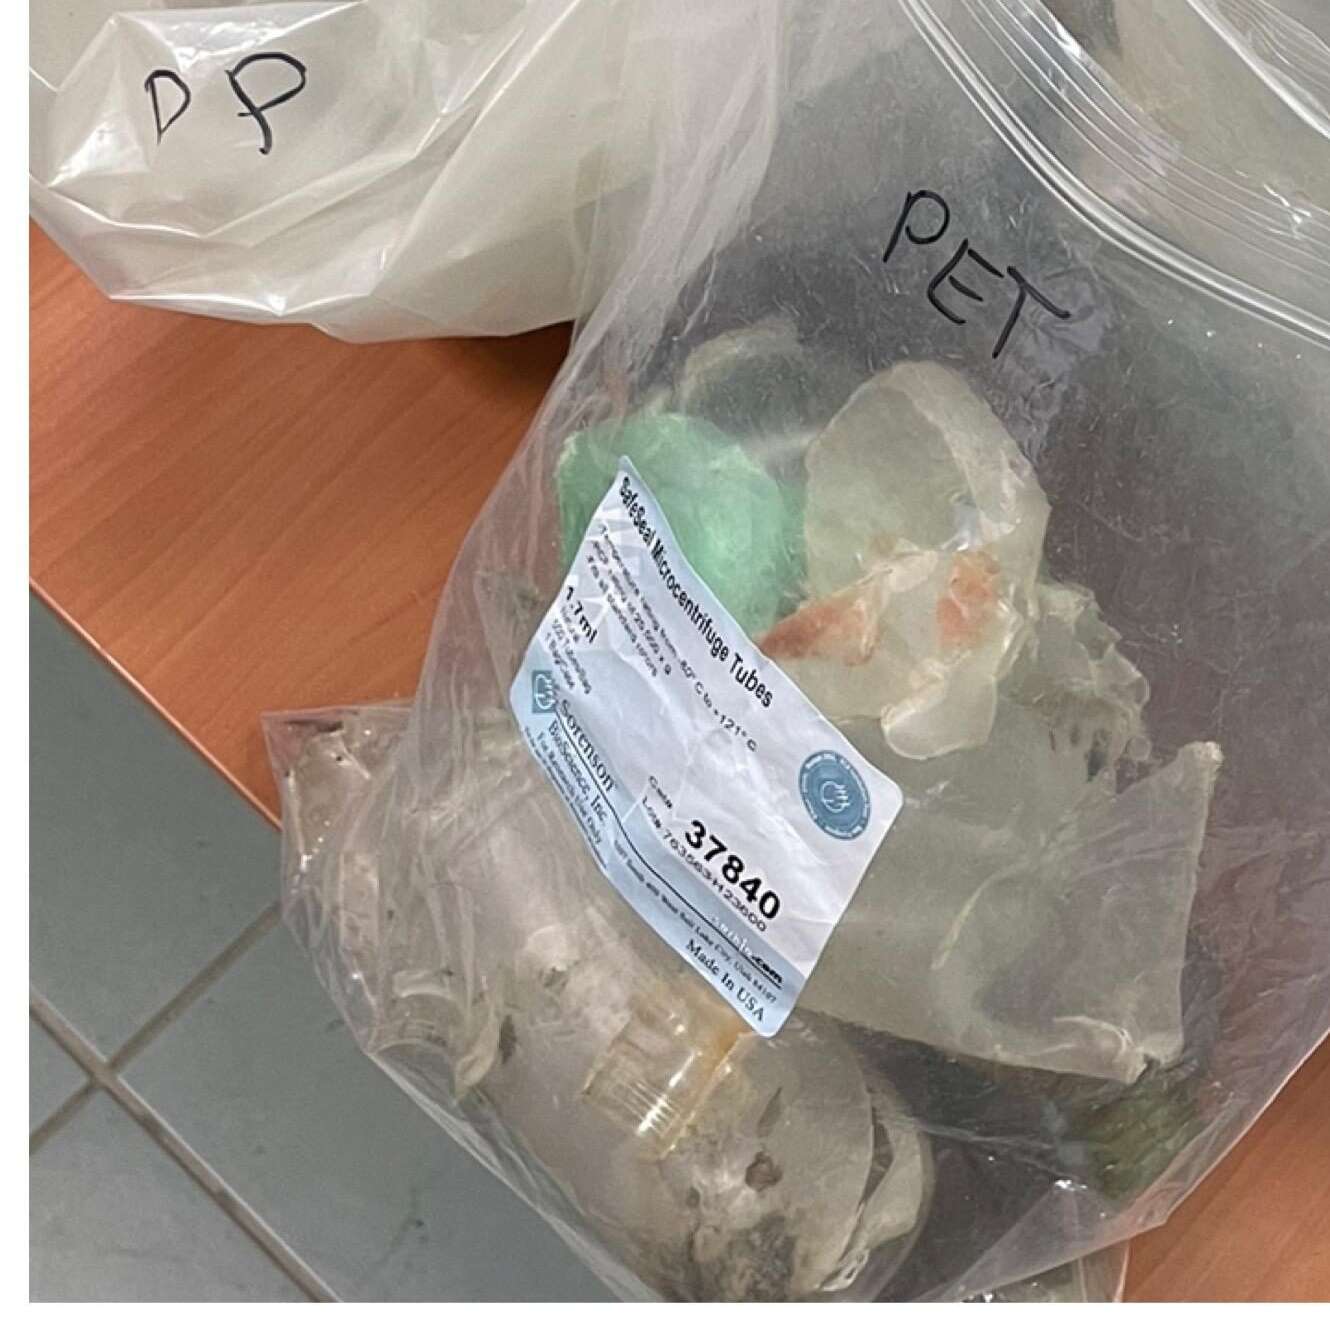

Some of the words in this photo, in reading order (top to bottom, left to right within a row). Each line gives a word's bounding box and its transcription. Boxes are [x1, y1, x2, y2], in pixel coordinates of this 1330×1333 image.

[883, 190, 1071, 359] PET
[619, 476, 657, 548] SafeSeal
[650, 538, 729, 662] Microcentrifuge
[727, 652, 774, 708] Tubes
[560, 699, 616, 793] Sorenson
[685, 819, 780, 920] 37840
[685, 938, 720, 976] Made
[720, 971, 735, 992] In
[736, 989, 766, 1022] USA
